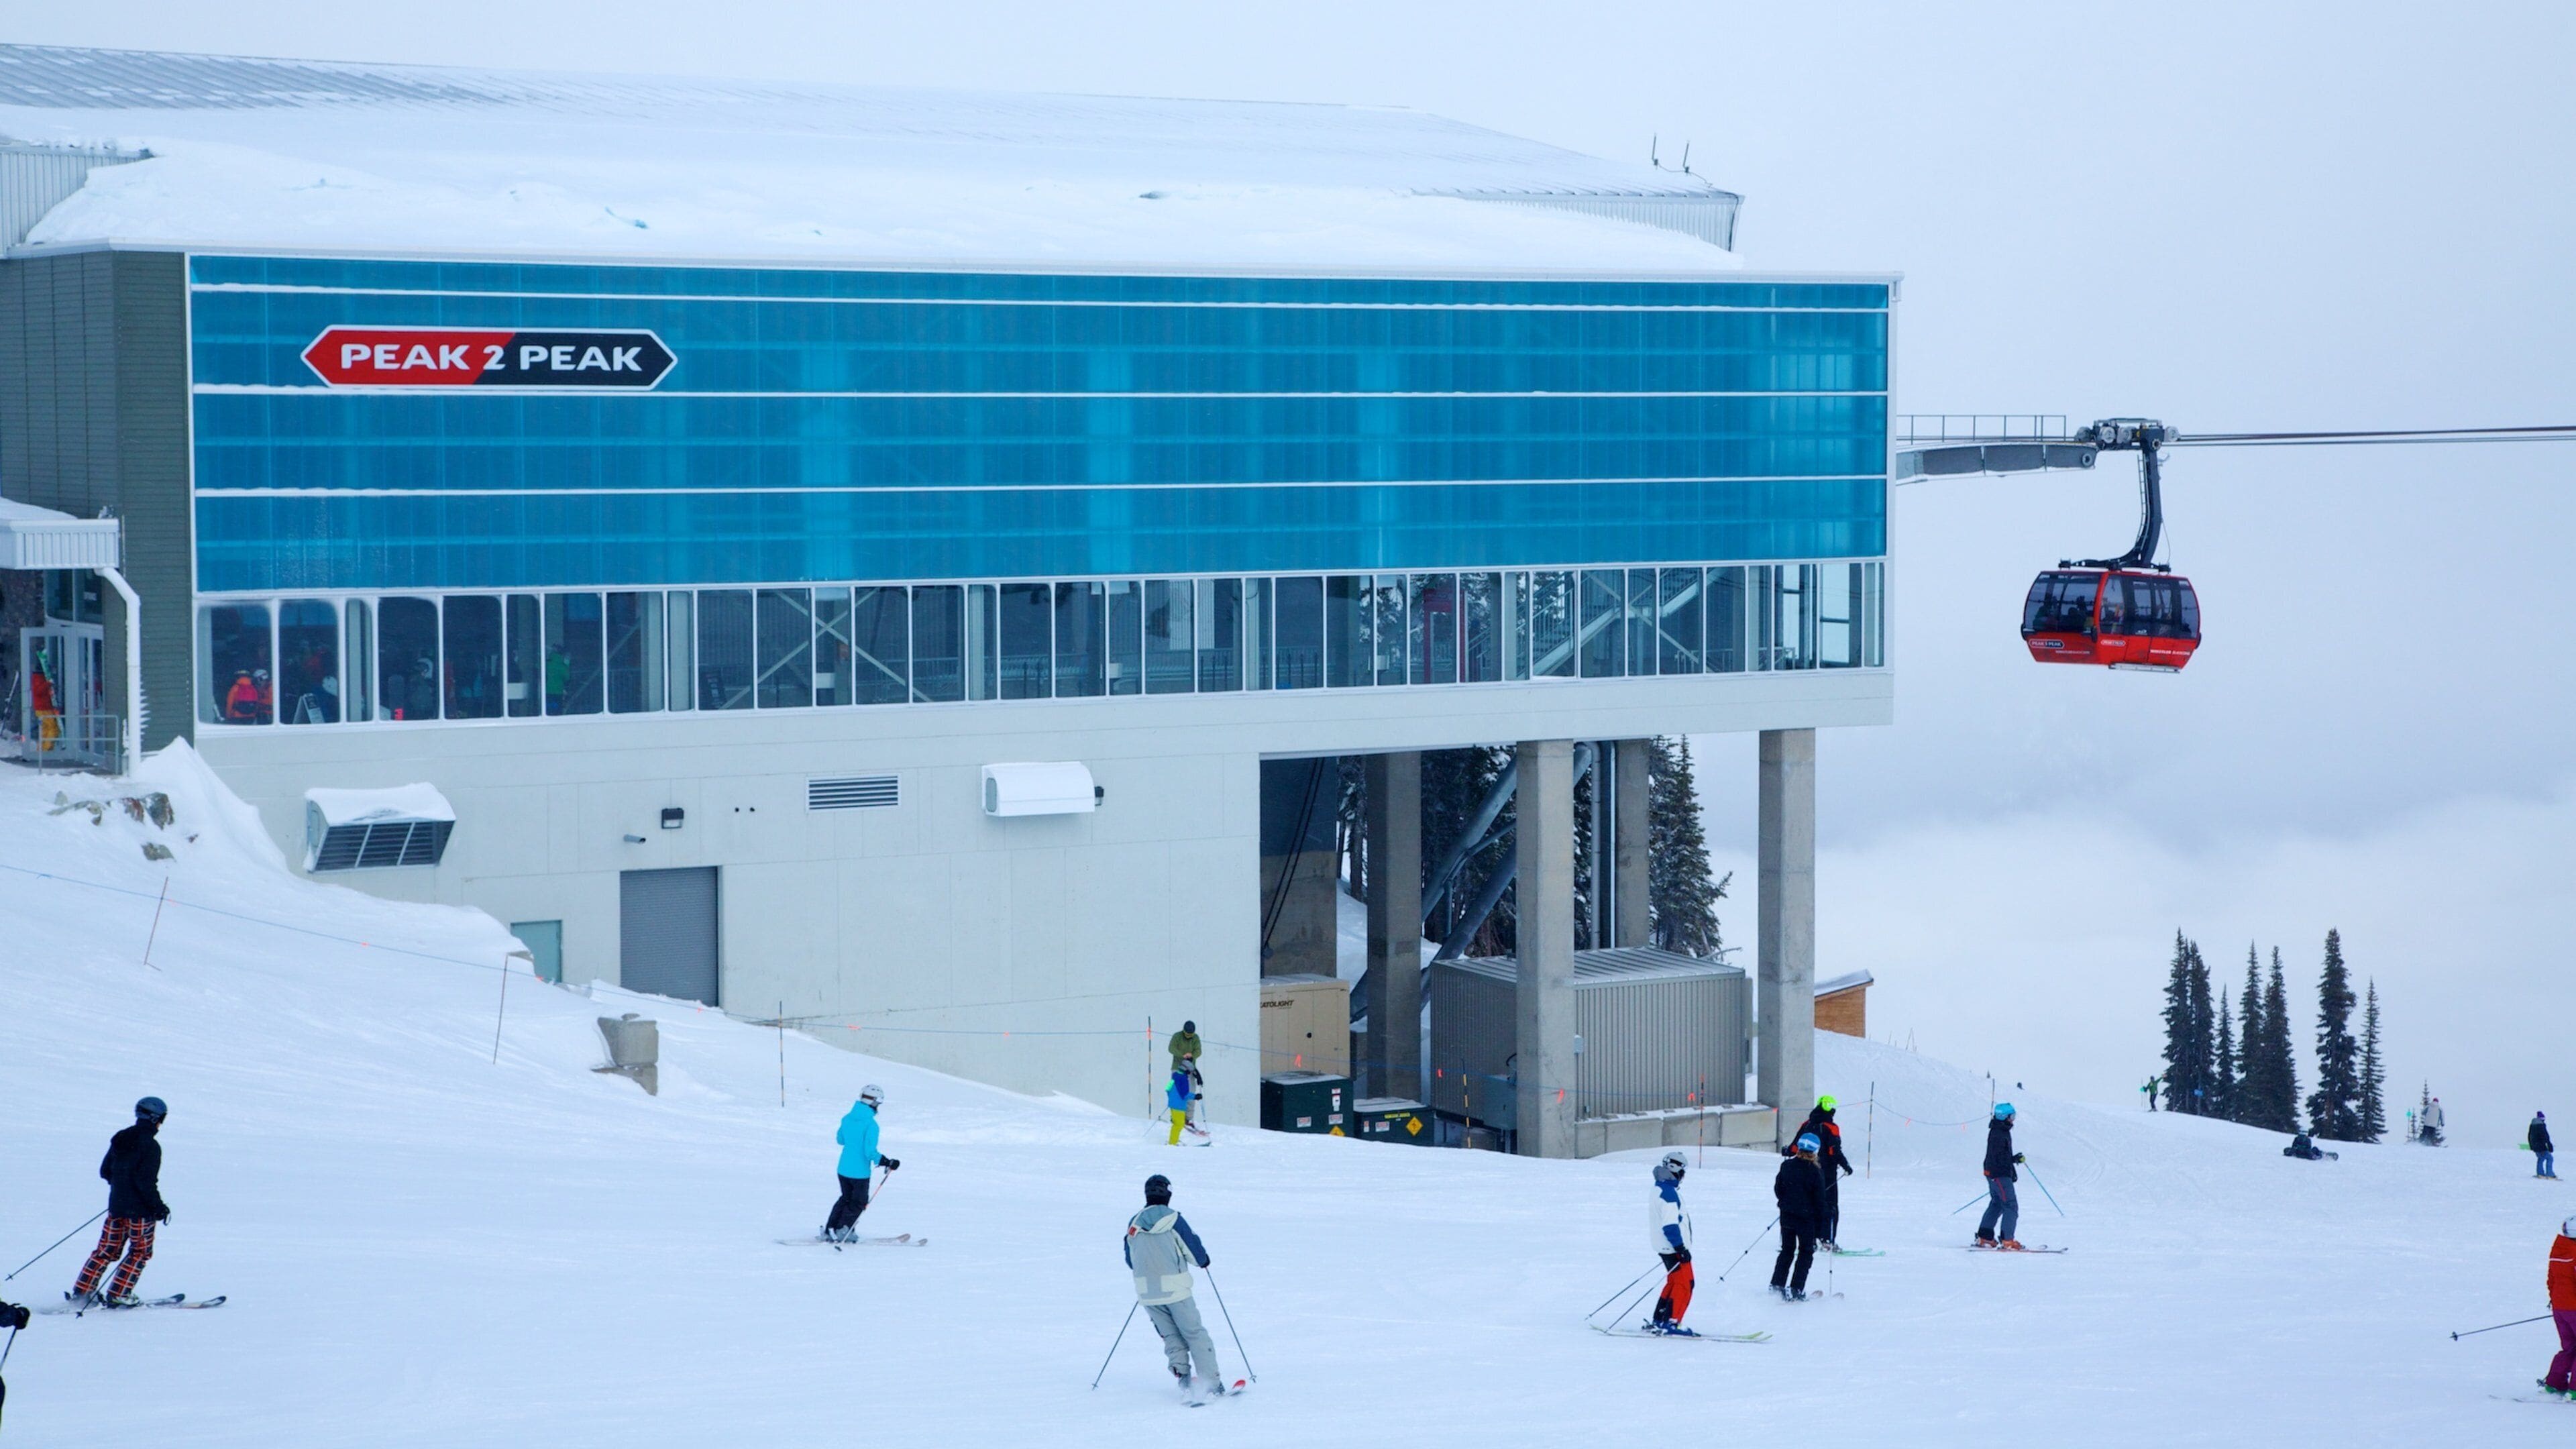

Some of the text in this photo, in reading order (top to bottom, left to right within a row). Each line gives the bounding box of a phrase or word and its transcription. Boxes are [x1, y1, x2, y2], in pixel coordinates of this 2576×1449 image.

[341, 343, 642, 371] PEAK 2 PEAK
